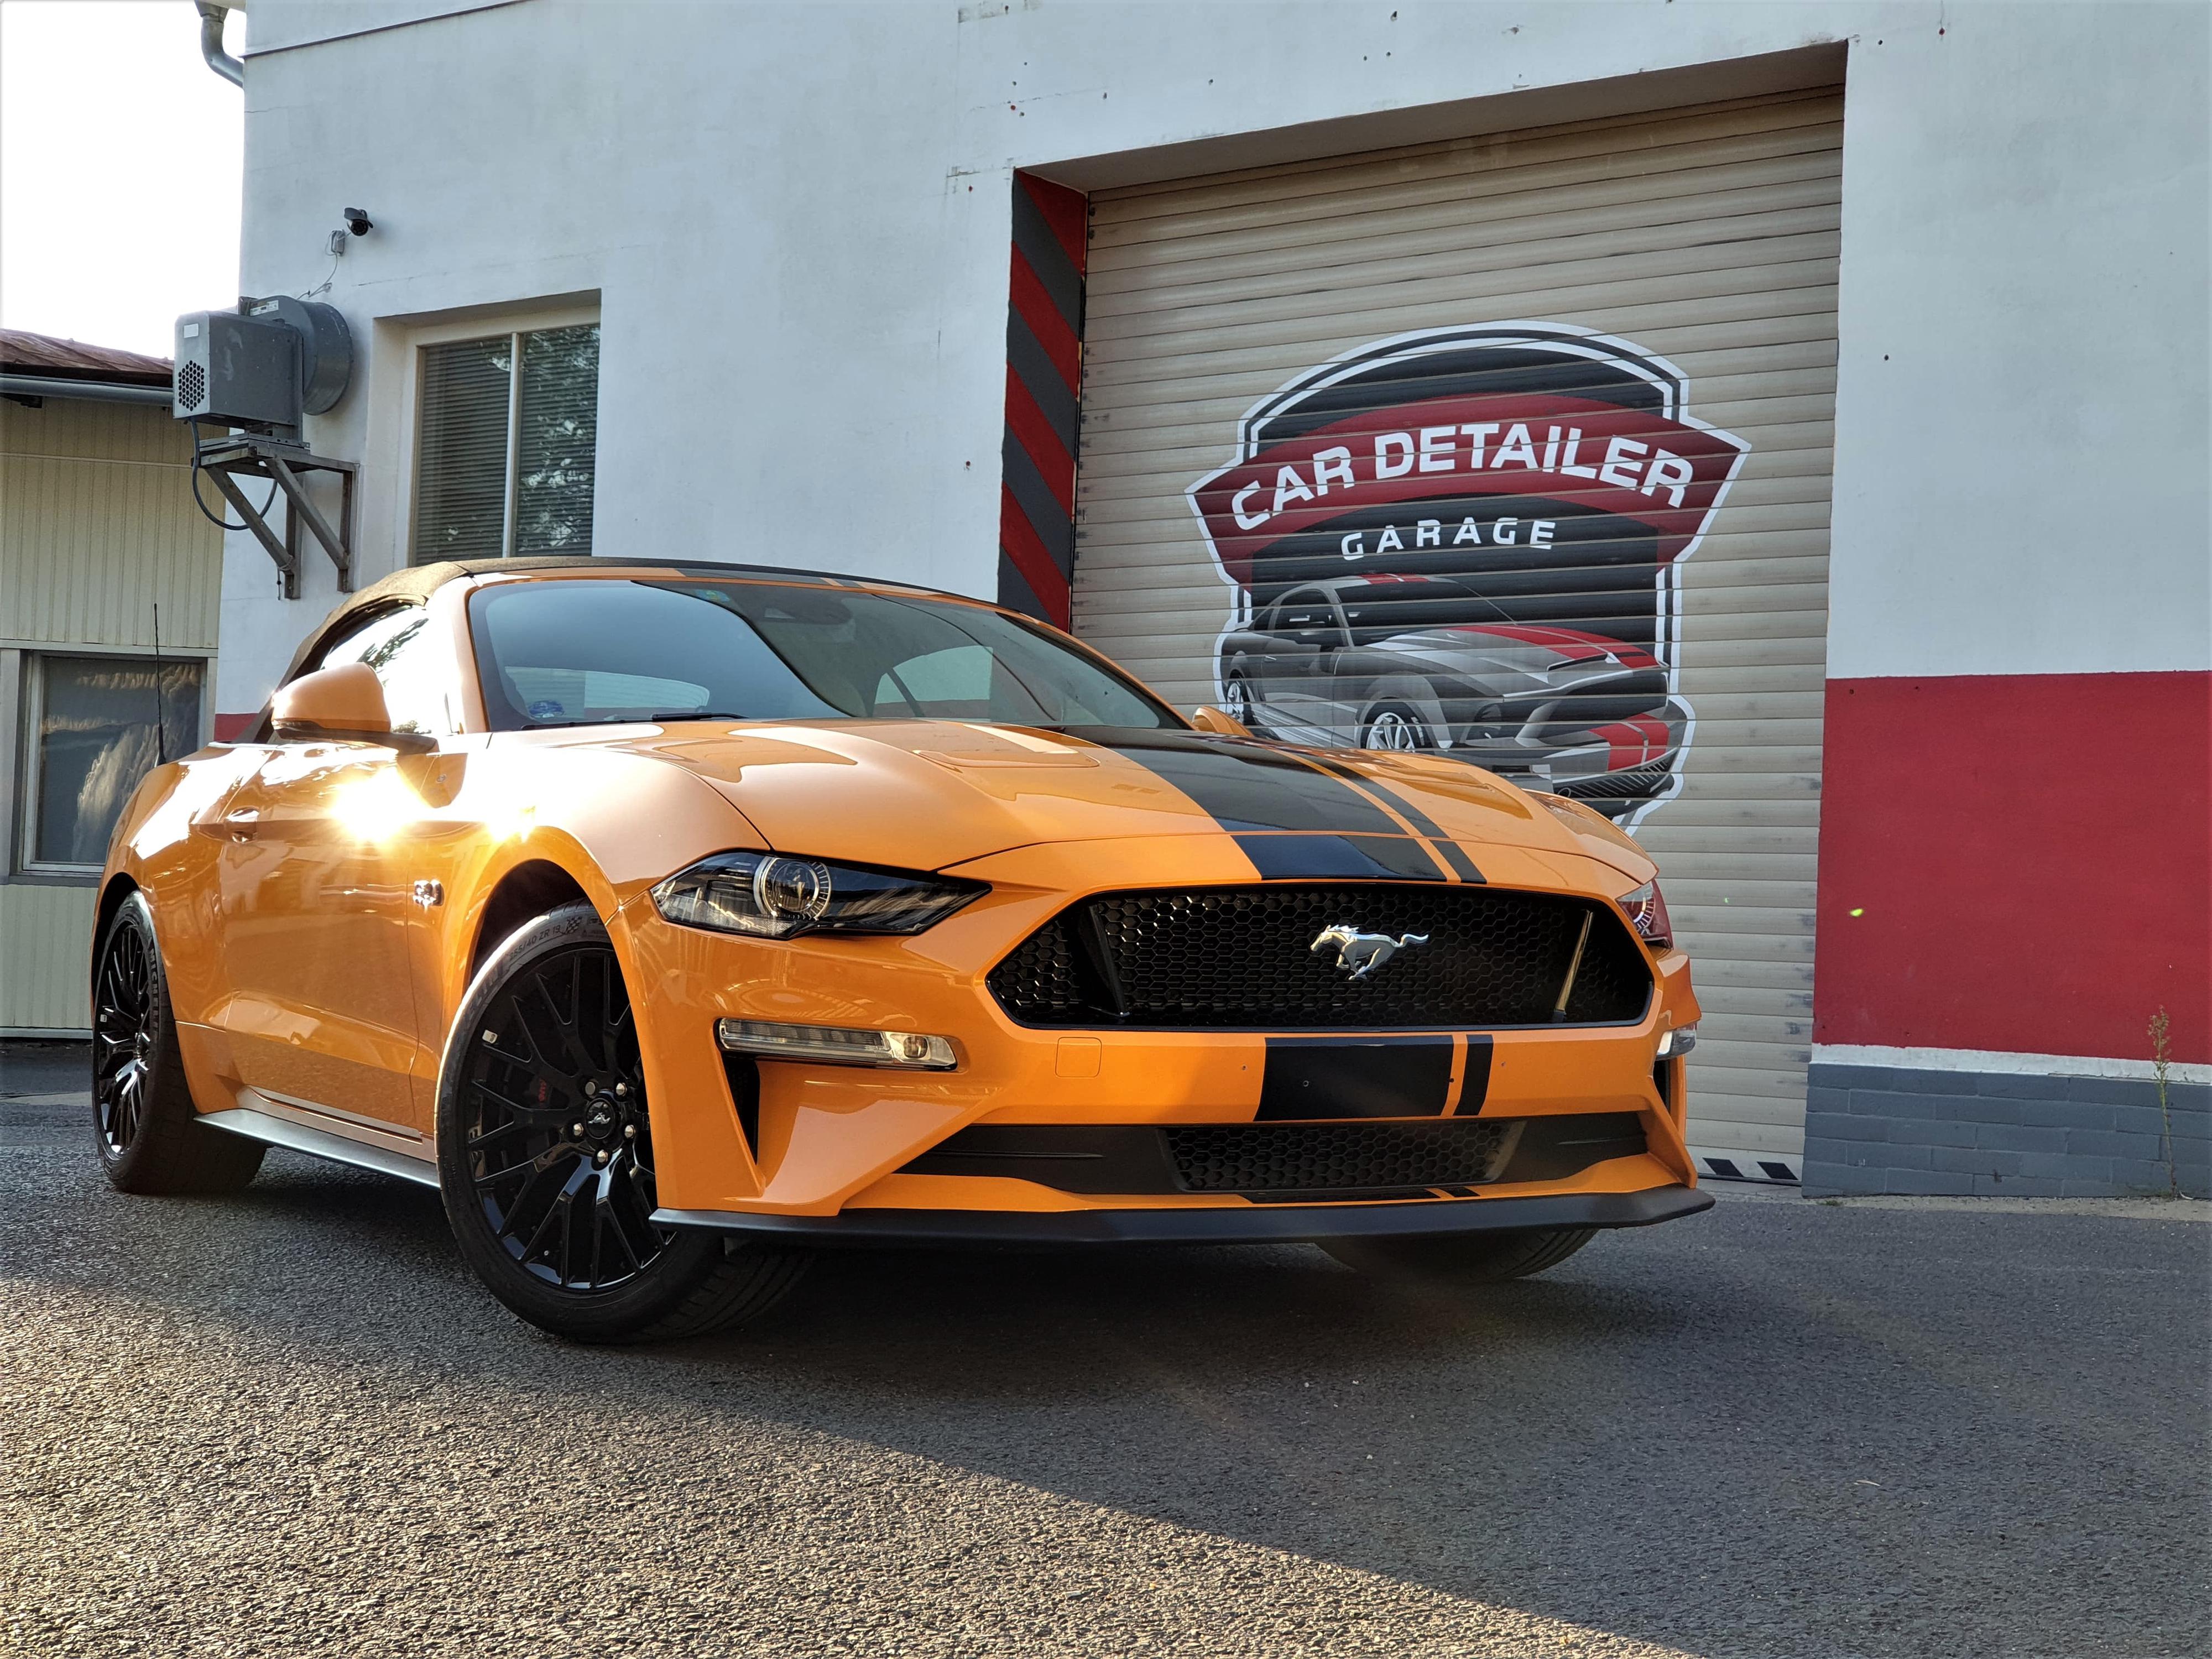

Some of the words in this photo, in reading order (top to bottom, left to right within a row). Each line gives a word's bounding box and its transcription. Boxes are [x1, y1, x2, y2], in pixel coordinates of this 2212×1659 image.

[1231, 445, 1355, 530] CAR
[1375, 422, 1693, 508] DETAILER
[1341, 517, 1556, 561] GARAGE
[538, 928, 550, 940] ZR
